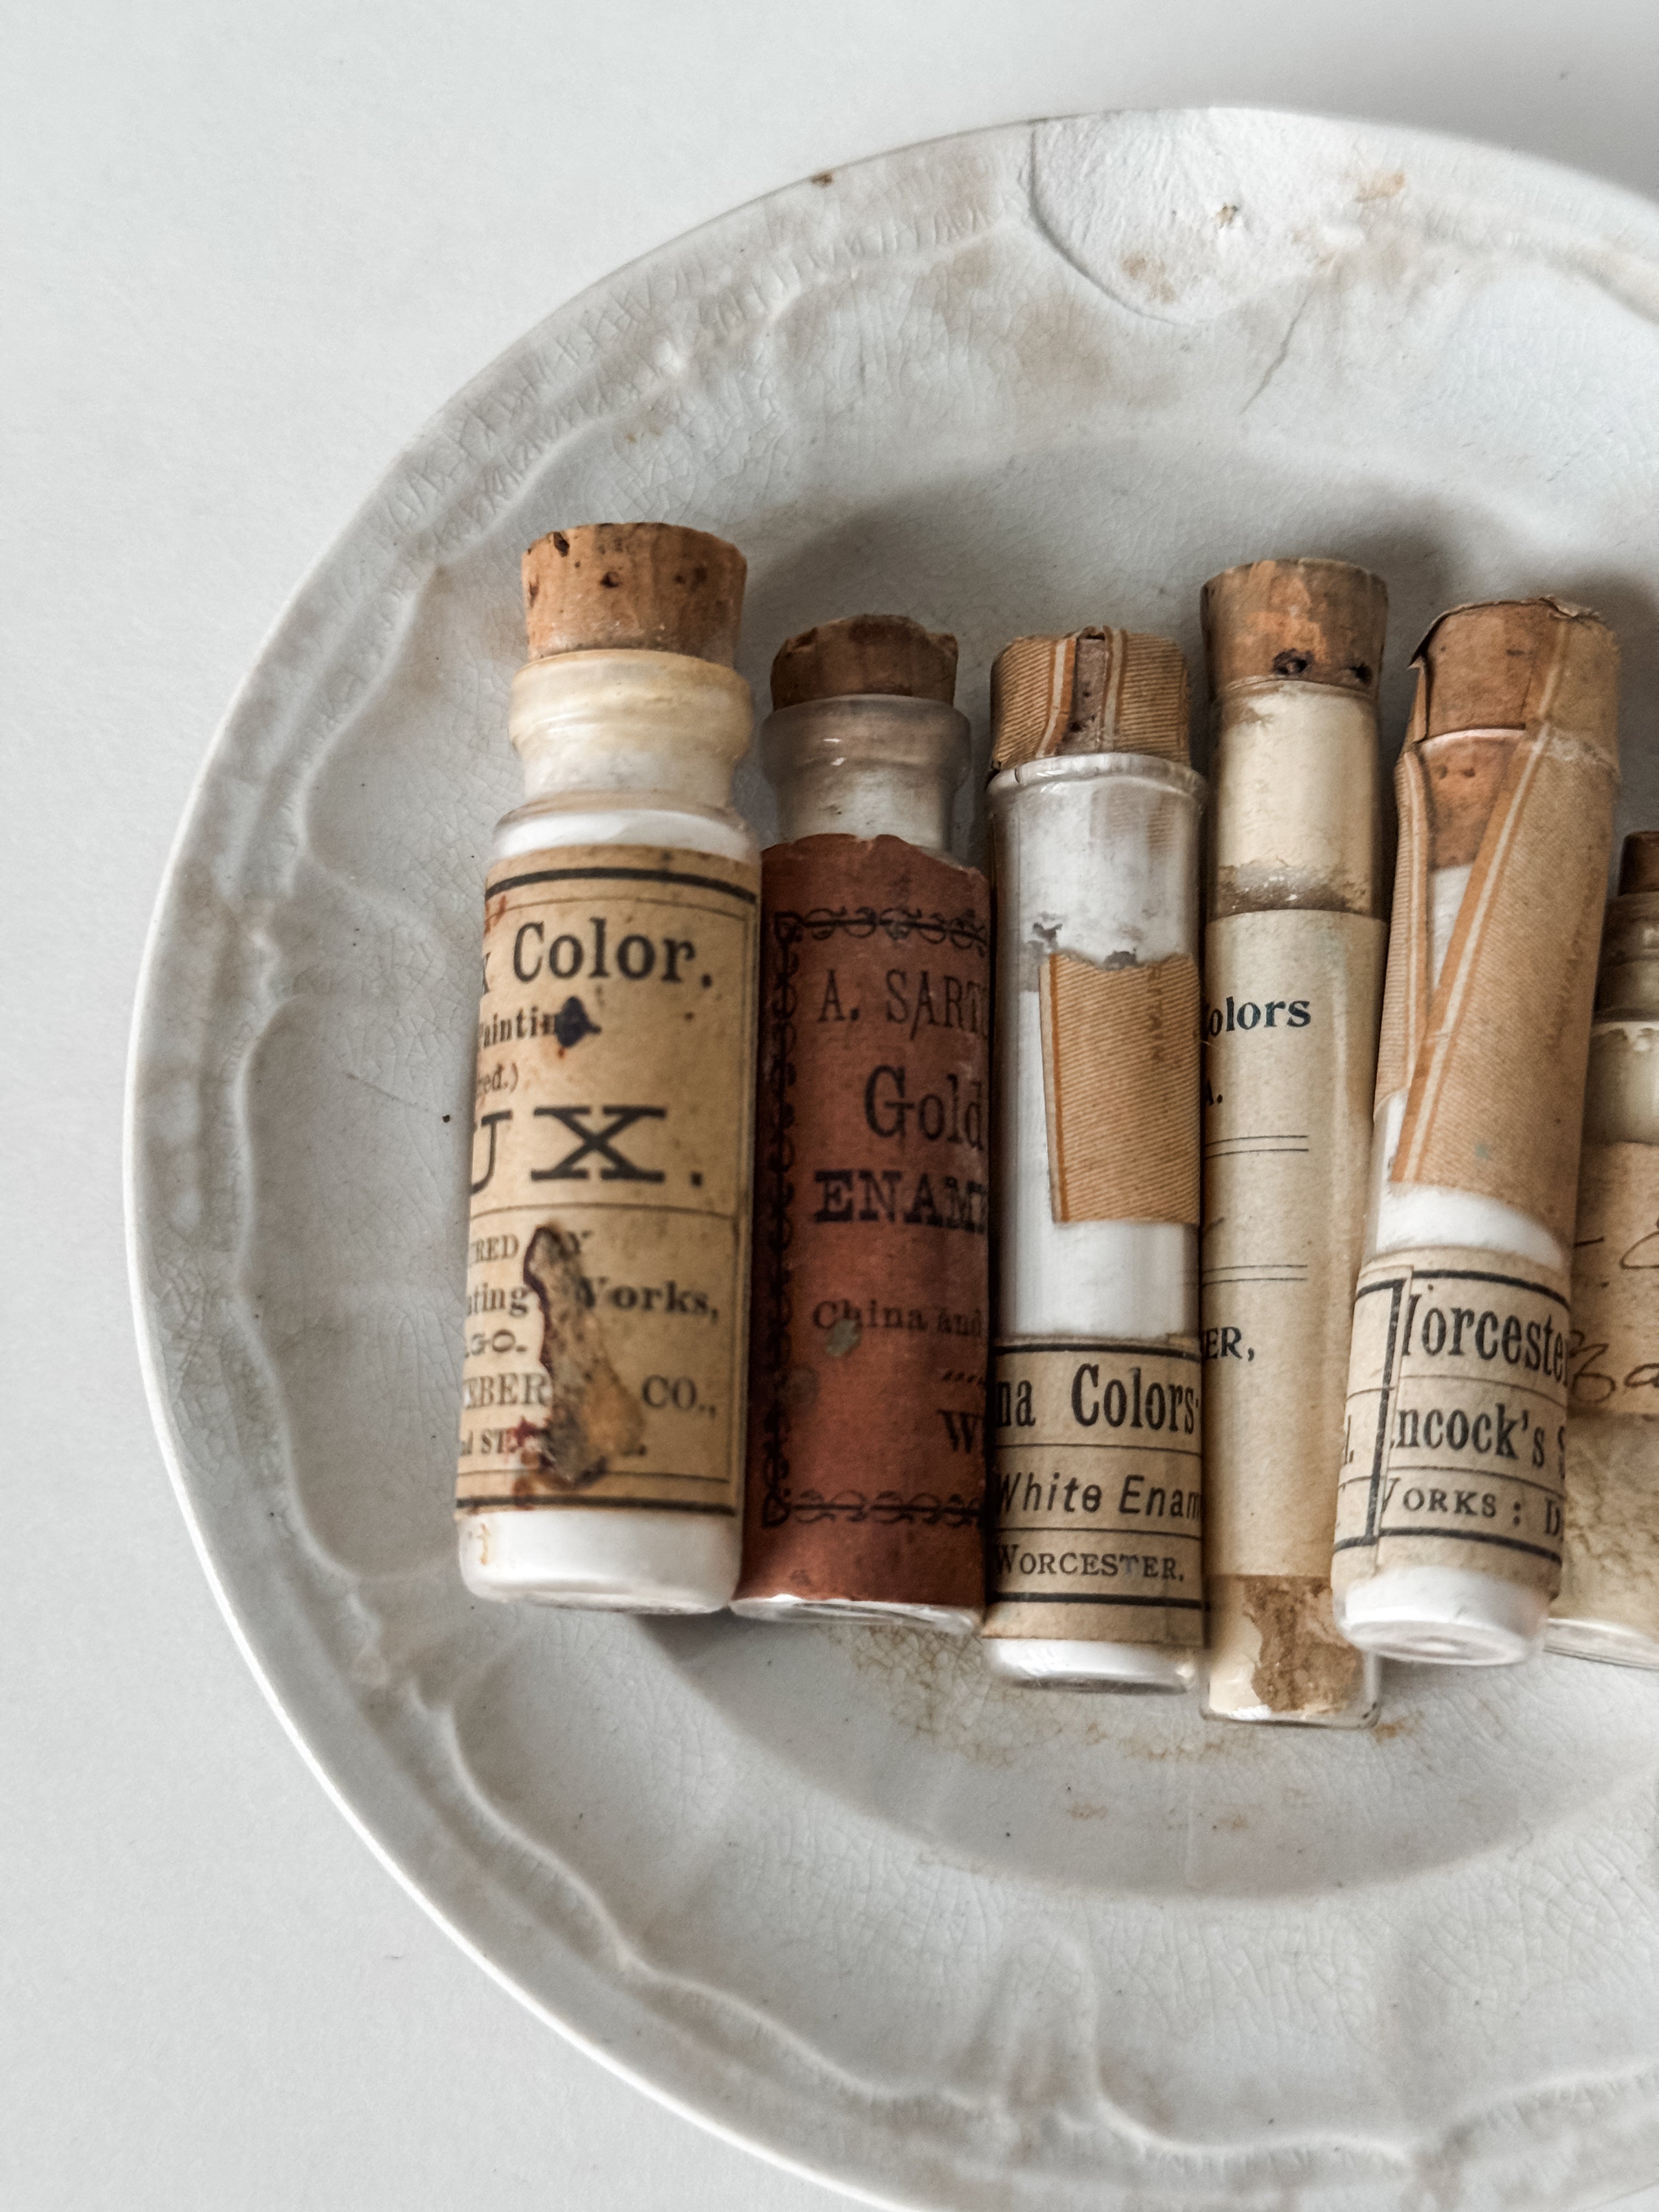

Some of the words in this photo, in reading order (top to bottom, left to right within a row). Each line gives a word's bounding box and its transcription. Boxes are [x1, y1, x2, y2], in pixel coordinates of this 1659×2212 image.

[511, 917, 713, 990] Color.
[816, 969, 860, 1023] A.
[1208, 995, 1311, 1037] olors
[864, 1064, 985, 1151] Gold
[812, 1298, 929, 1333] China
[1203, 1326, 1256, 1362] ER,
[1390, 1402, 1547, 1469] ncock's
[996, 1472, 1102, 1516] White
